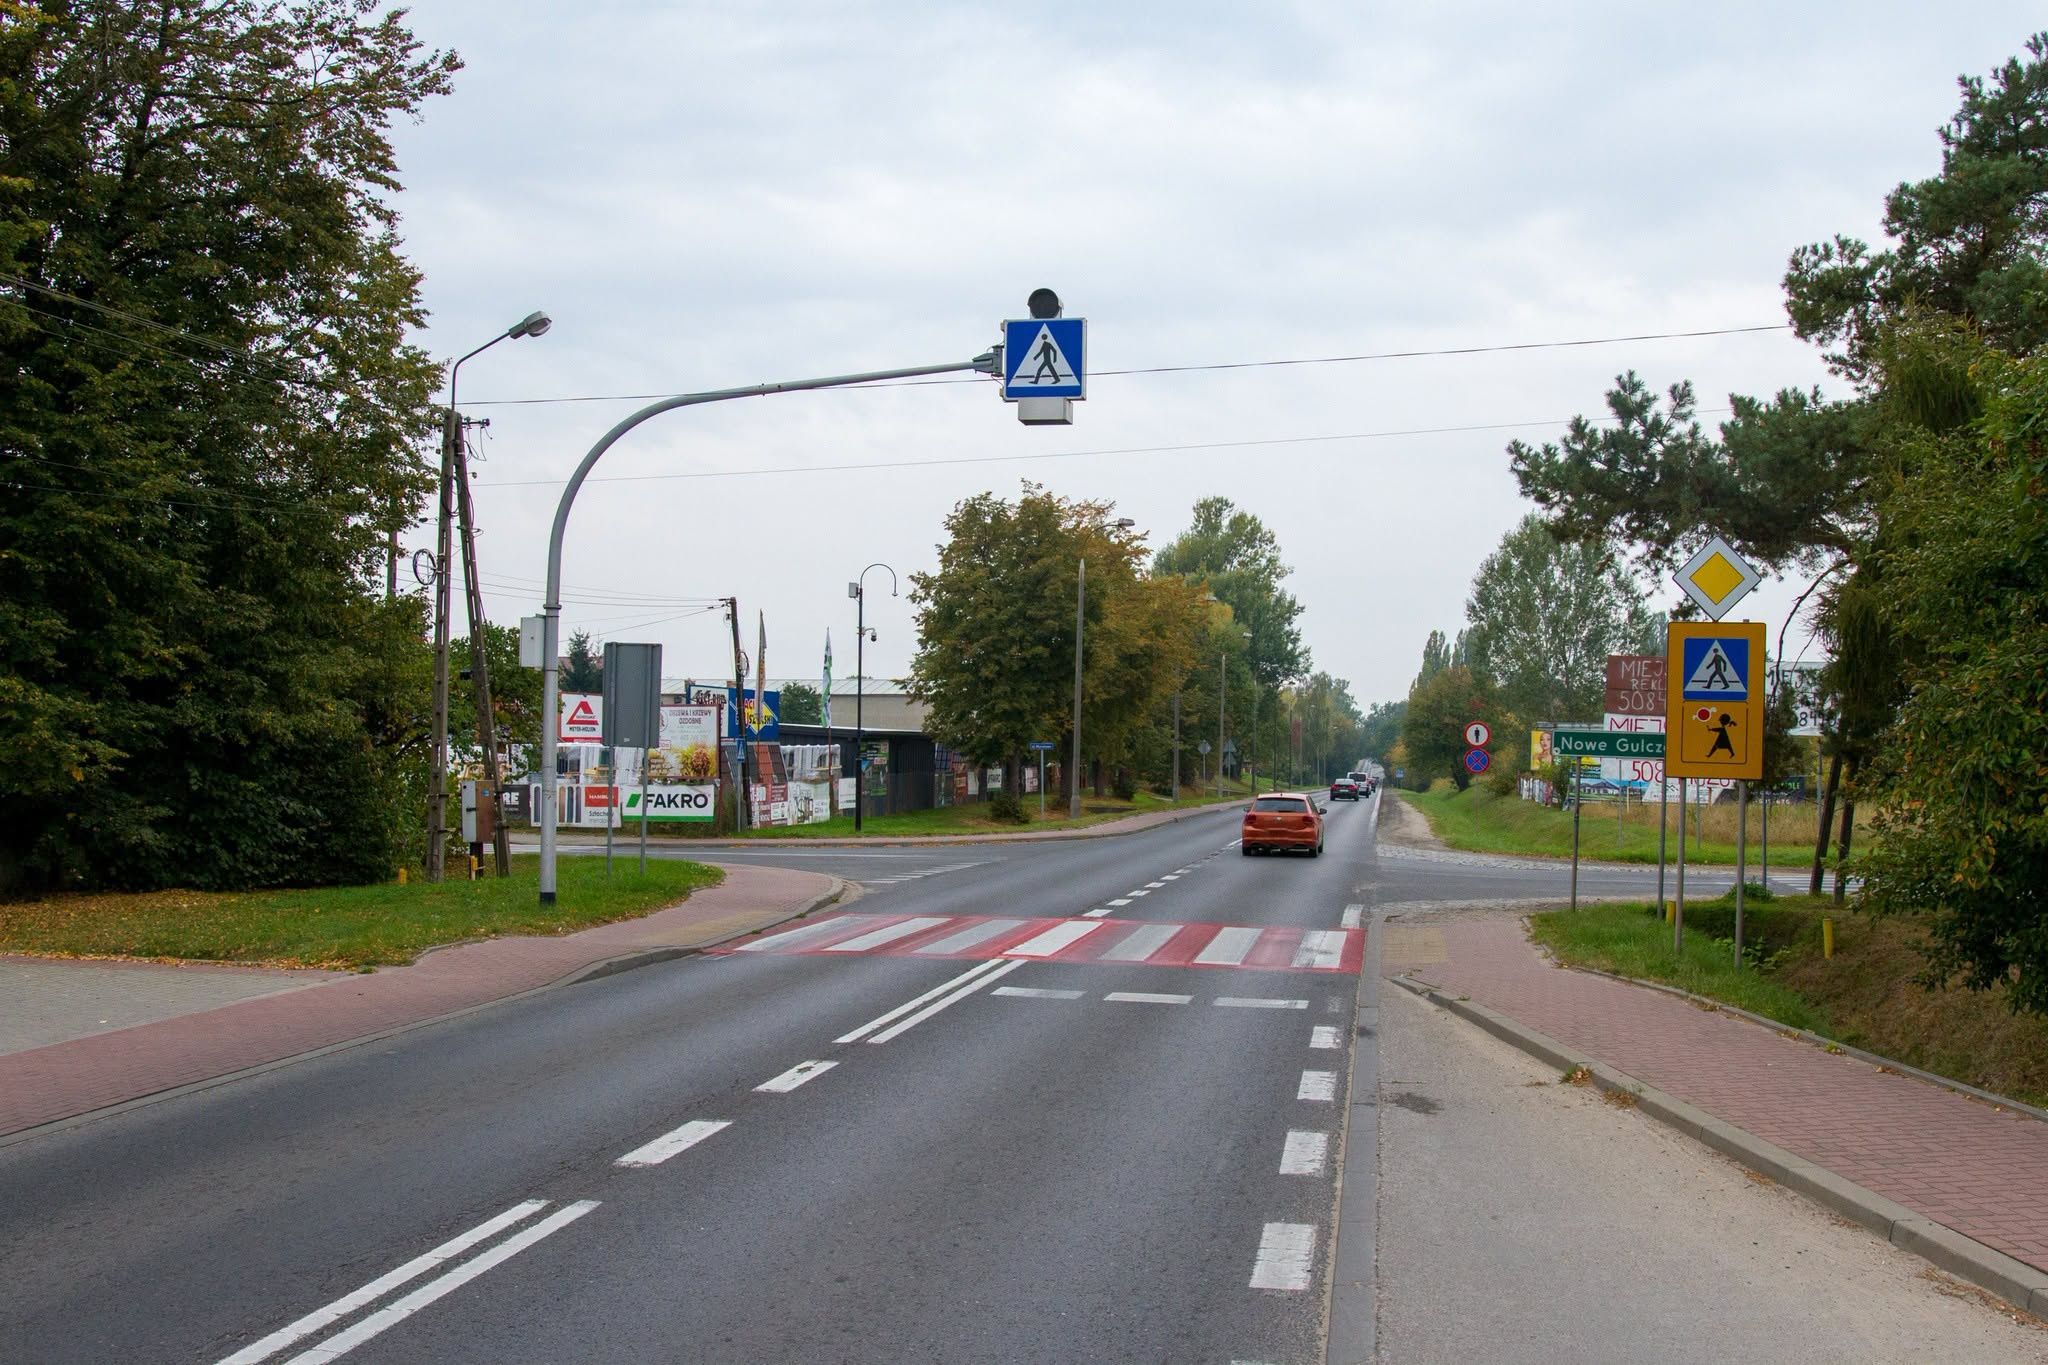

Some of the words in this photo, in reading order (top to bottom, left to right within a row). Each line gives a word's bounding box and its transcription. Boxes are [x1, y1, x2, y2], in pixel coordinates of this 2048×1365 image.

[1561, 736, 1607, 751] Nowe
[1616, 738, 1665, 753] Gulcz
[646, 793, 709, 808] FAKRO
